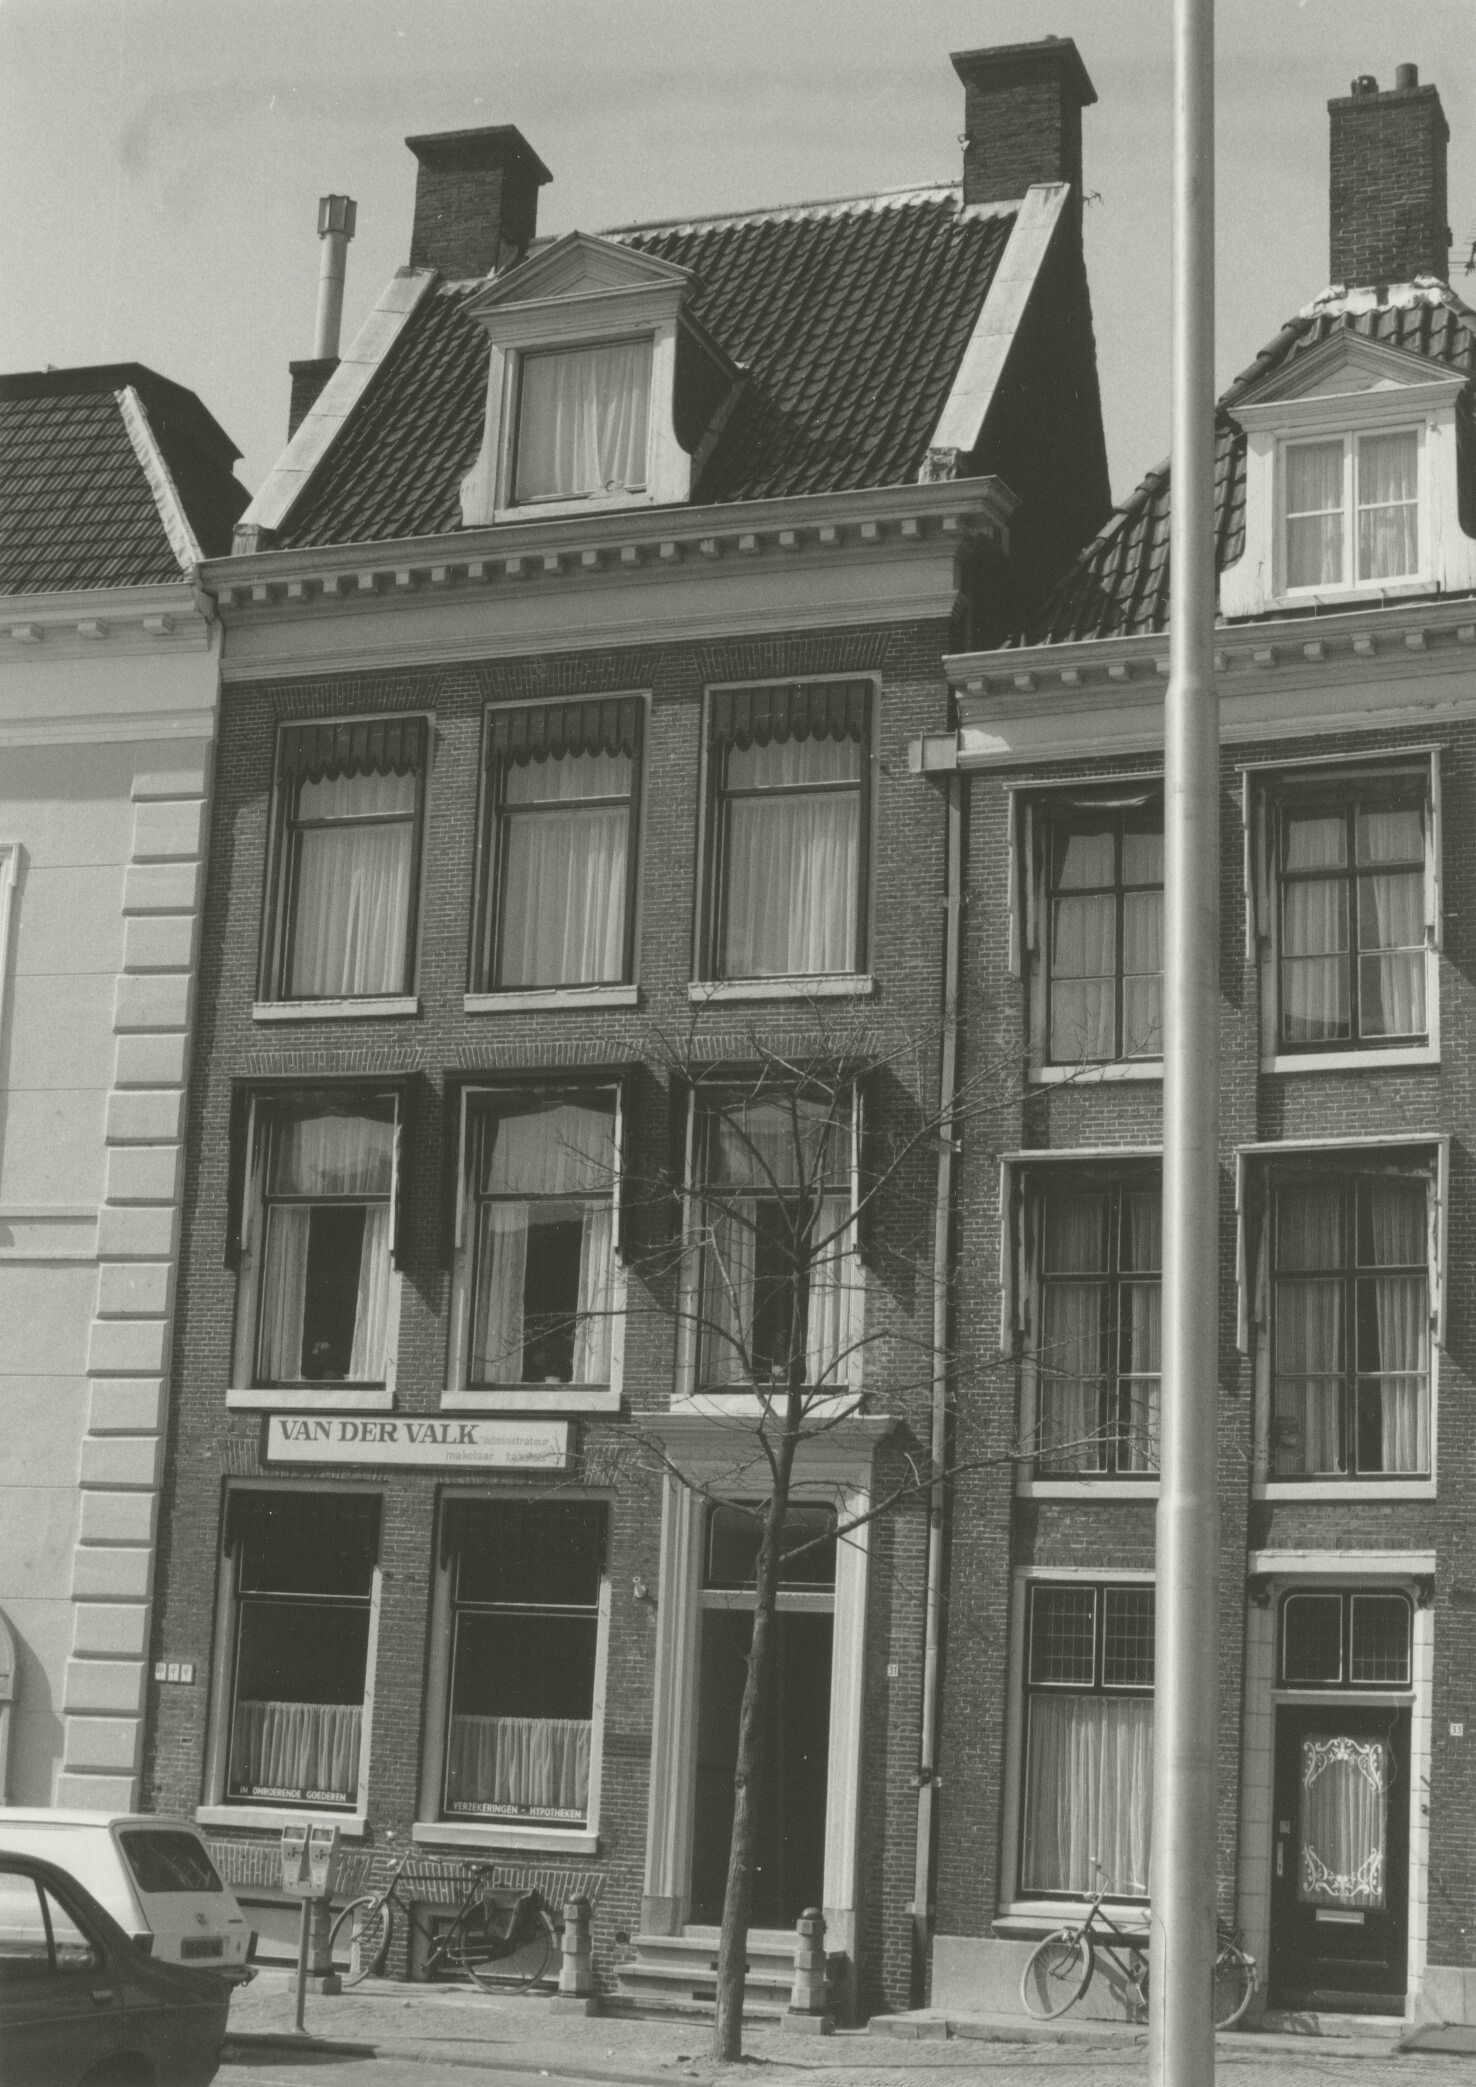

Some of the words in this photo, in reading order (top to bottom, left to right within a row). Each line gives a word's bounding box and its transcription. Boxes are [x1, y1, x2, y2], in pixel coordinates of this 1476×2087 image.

[278, 1420, 333, 1442] VAN
[337, 1421, 398, 1443] DER
[403, 1422, 480, 1446] VALK
[446, 1450, 494, 1461] makelaar
[888, 1665, 898, 1676] 31
[1451, 1724, 1462, 1735] 33
[240, 1785, 249, 1795] IN
[252, 1785, 302, 1799] ONROERENDE
[306, 1790, 347, 1802] GOEDEREN
[453, 1801, 518, 1815] VERZEKERINGEN
[529, 1806, 582, 1819] HYPOTHEKEN
